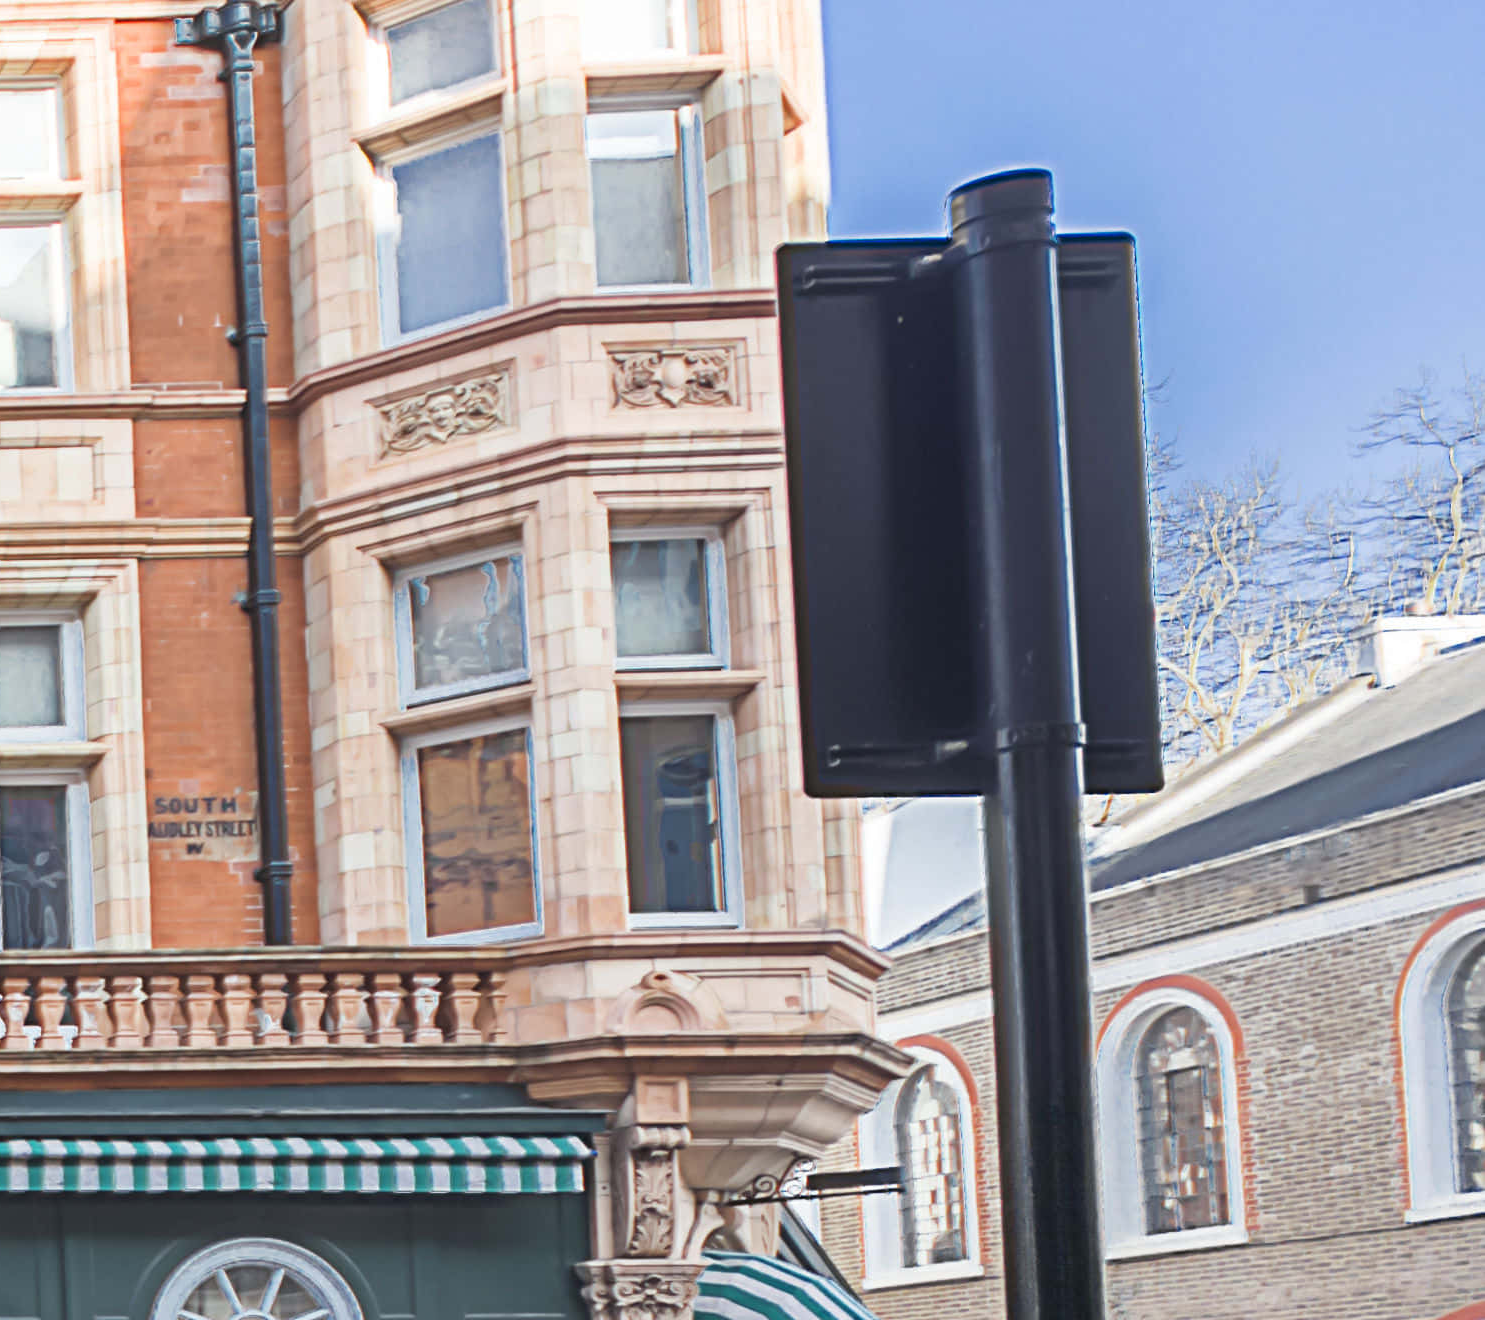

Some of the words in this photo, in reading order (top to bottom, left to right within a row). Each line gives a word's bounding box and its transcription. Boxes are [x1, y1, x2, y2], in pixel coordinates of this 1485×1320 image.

[154, 797, 237, 814] SOUTH
[148, 821, 203, 838] AUDLEY
[206, 819, 257, 837] STREET
